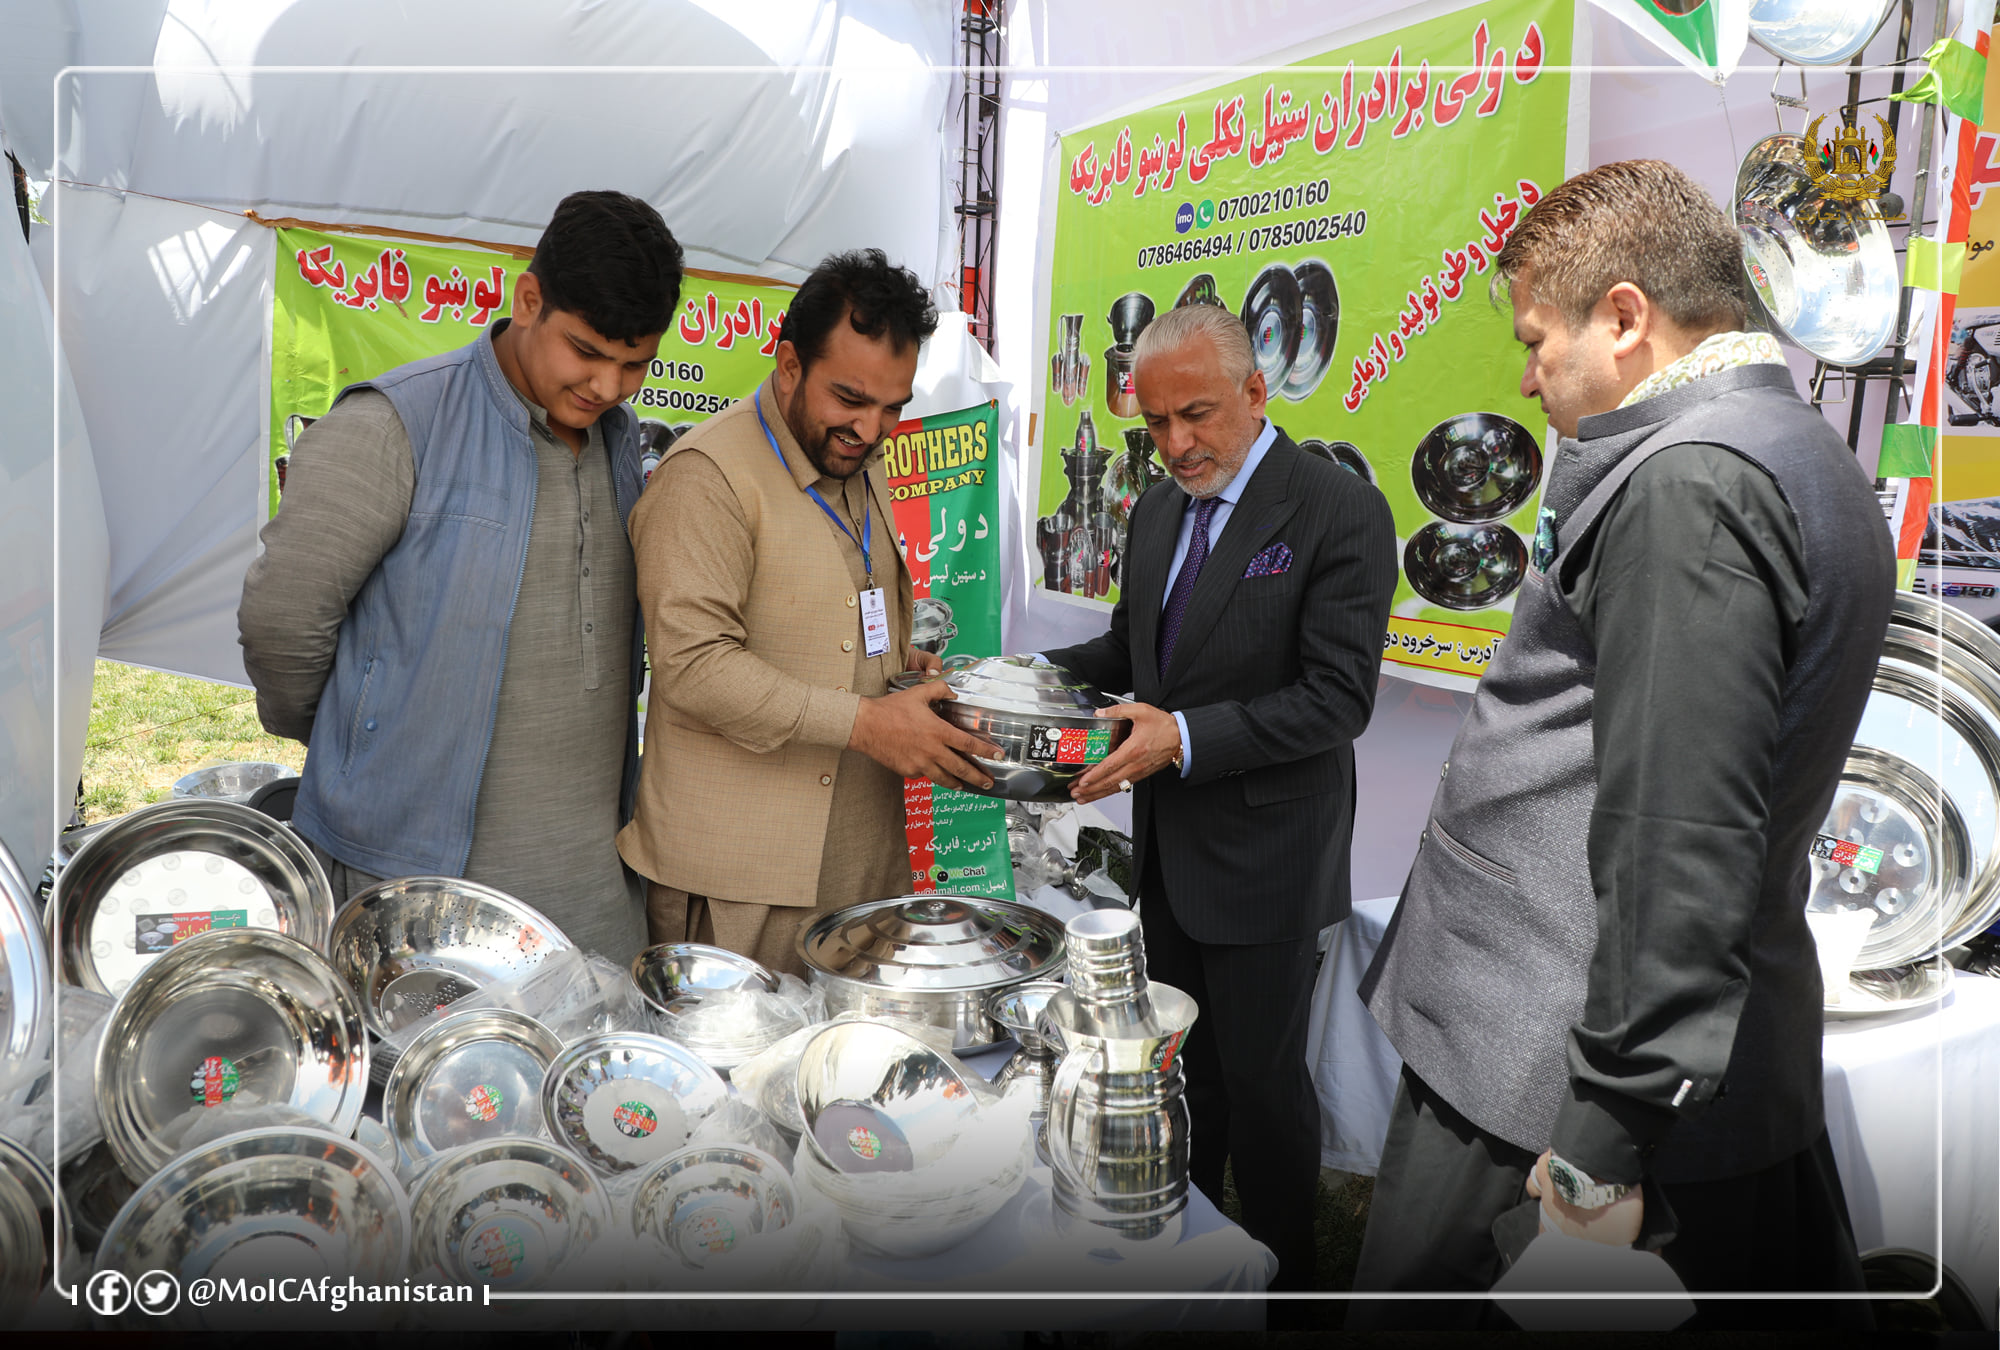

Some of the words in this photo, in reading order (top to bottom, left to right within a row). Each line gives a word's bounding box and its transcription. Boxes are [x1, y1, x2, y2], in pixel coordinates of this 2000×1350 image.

[1432, 19, 1506, 127] ولی
[1513, 20, 1545, 84] د
[1313, 46, 1429, 155] برادران
[1070, 126, 1133, 206] فابریکه
[1188, 95, 1245, 182] نکلی
[1218, 179, 1329, 222] 0700210160
[1138, 233, 1232, 269] 0786466494
[1249, 210, 1367, 251] 0785002540
[297, 244, 411, 311] فابریکه
[883, 421, 988, 478] ROTHERS
[912, 871, 925, 881] 89
[949, 866, 986, 879] WeChat
[925, 836, 960, 855] فابریکه
